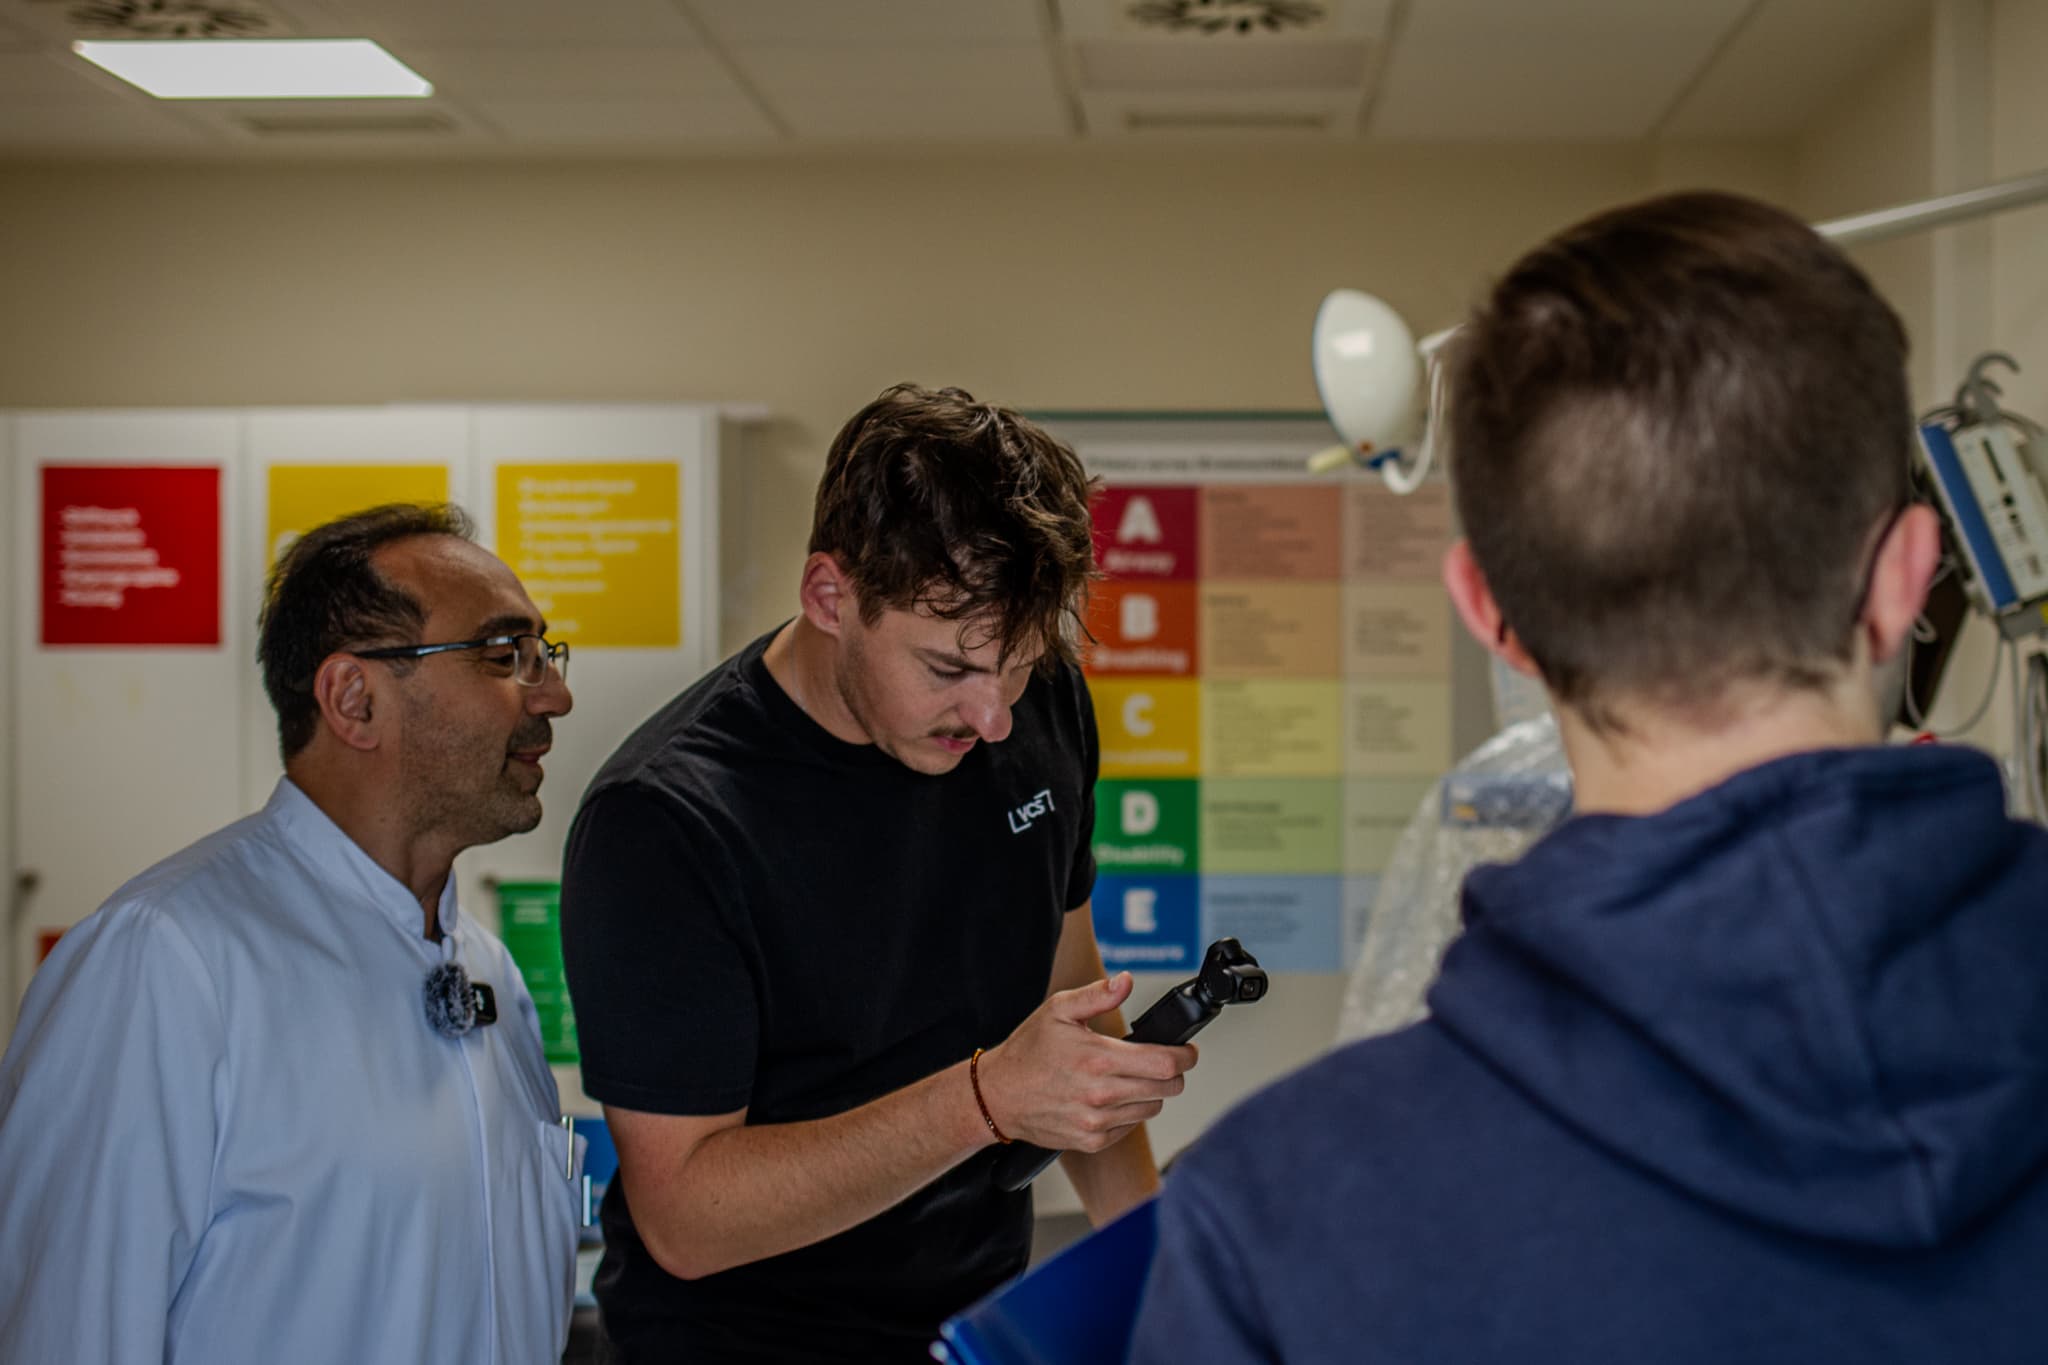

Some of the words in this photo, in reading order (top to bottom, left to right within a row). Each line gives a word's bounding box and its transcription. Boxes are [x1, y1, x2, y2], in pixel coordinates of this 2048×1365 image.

[1117, 496, 1162, 544] A
[1120, 595, 1159, 640] B
[1122, 694, 1155, 737] C
[1121, 791, 1159, 836] D
[1122, 889, 1158, 934] E
